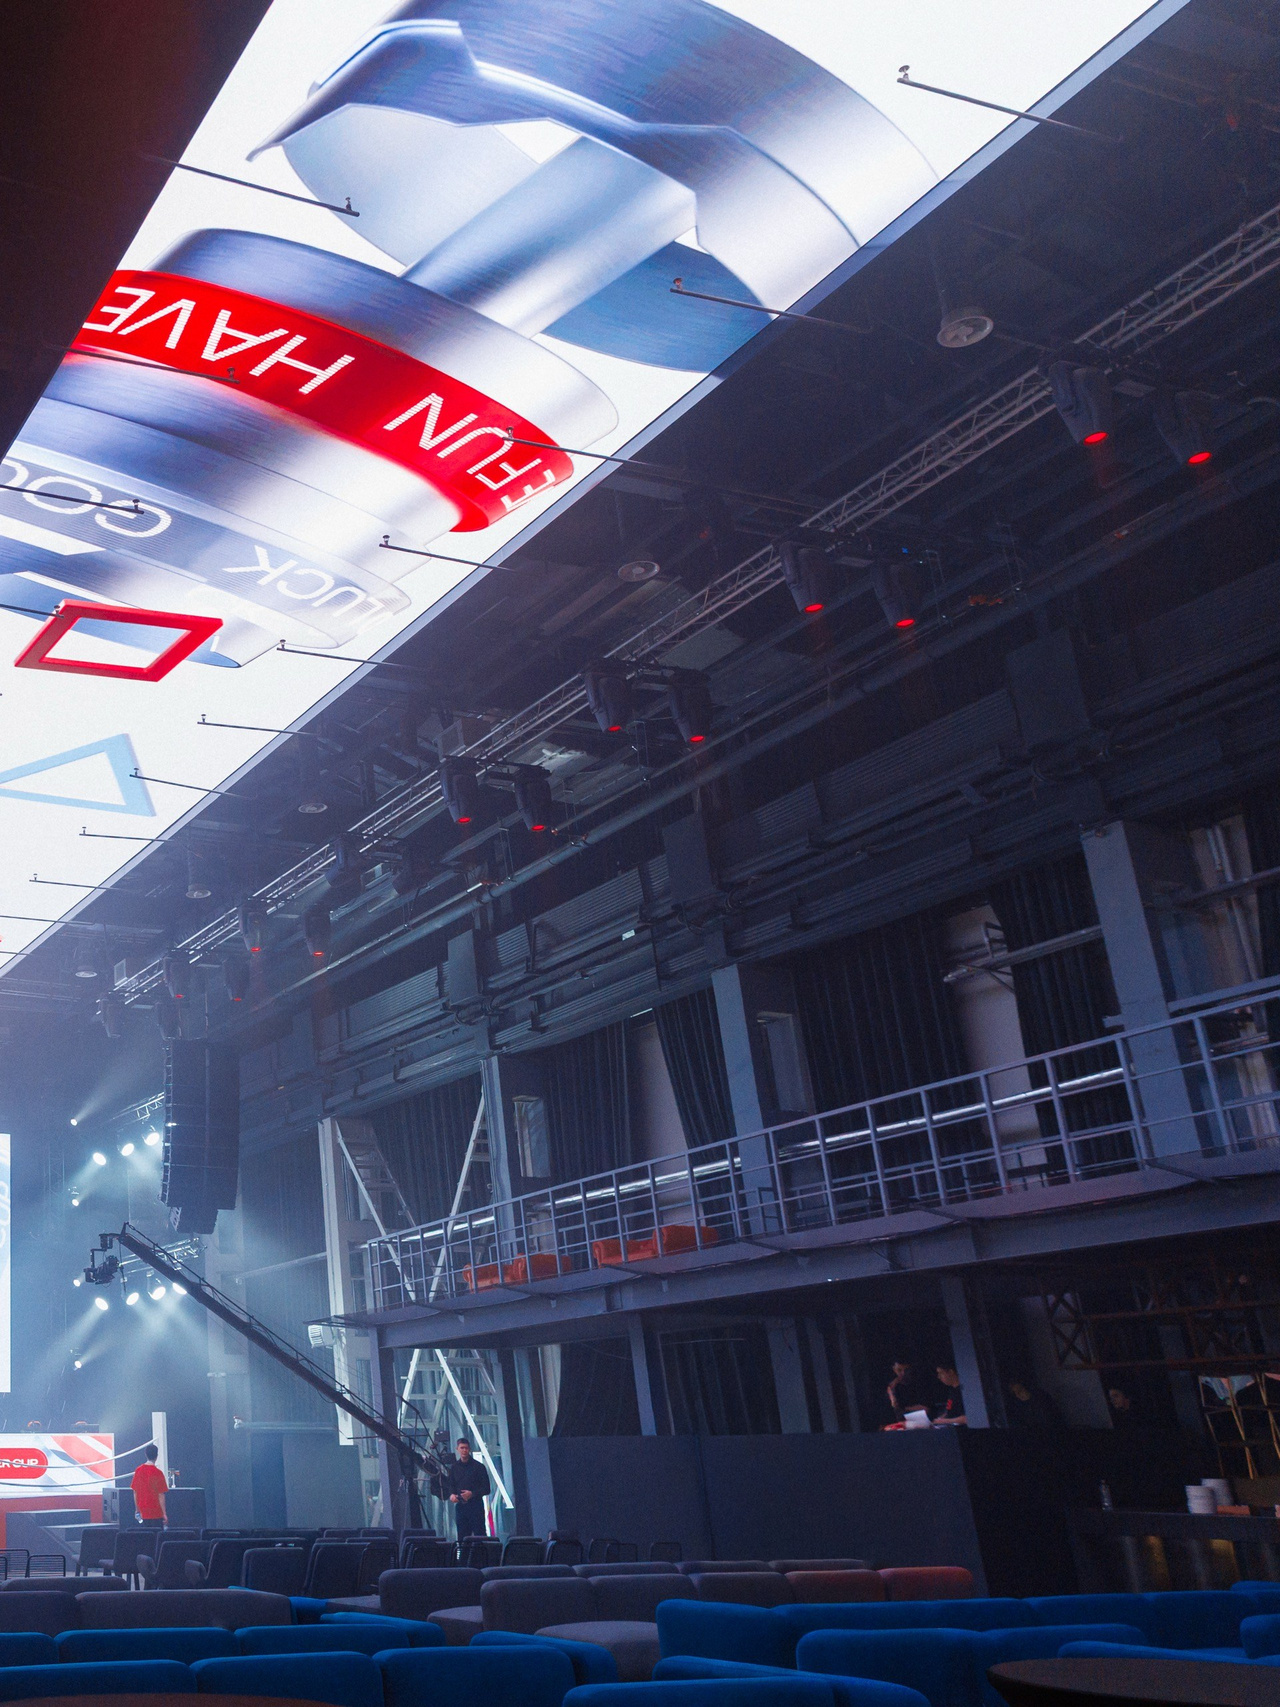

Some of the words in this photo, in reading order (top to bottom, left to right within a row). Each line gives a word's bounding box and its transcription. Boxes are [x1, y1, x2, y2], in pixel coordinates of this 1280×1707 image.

[82, 286, 355, 394] HAVE
[383, 393, 542, 490] FUN
[222, 545, 385, 628] LUCK
[11, 1459, 39, 1469] CUP
